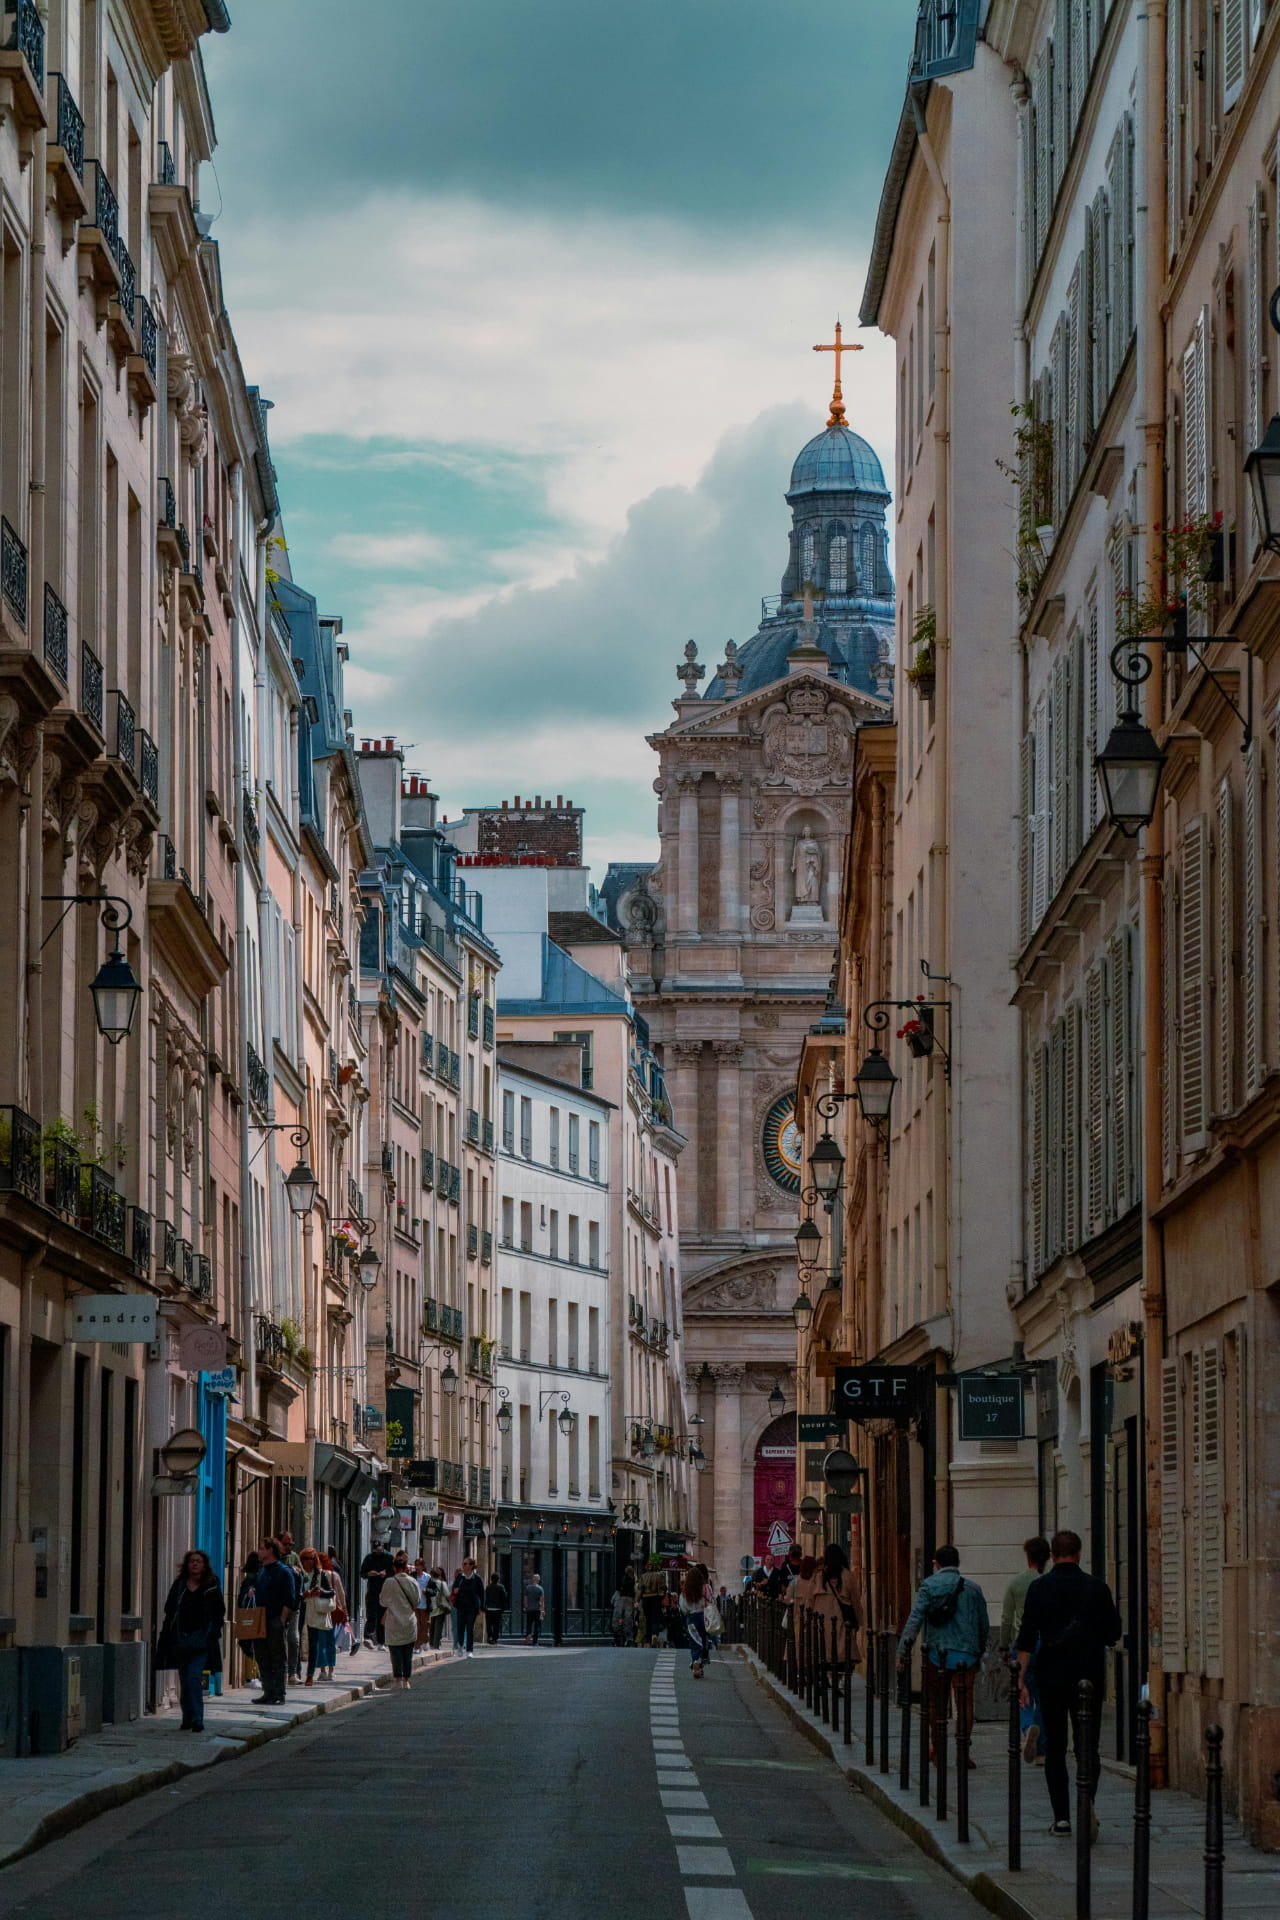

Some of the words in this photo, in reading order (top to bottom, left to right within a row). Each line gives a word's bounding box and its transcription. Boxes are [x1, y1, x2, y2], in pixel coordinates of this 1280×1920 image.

[77, 1312, 151, 1323] sandro
[843, 1378, 907, 1397] GTF
[968, 1393, 1015, 1405] boutique
[985, 1413, 999, 1422] 17
[278, 1464, 305, 1472] ANY
